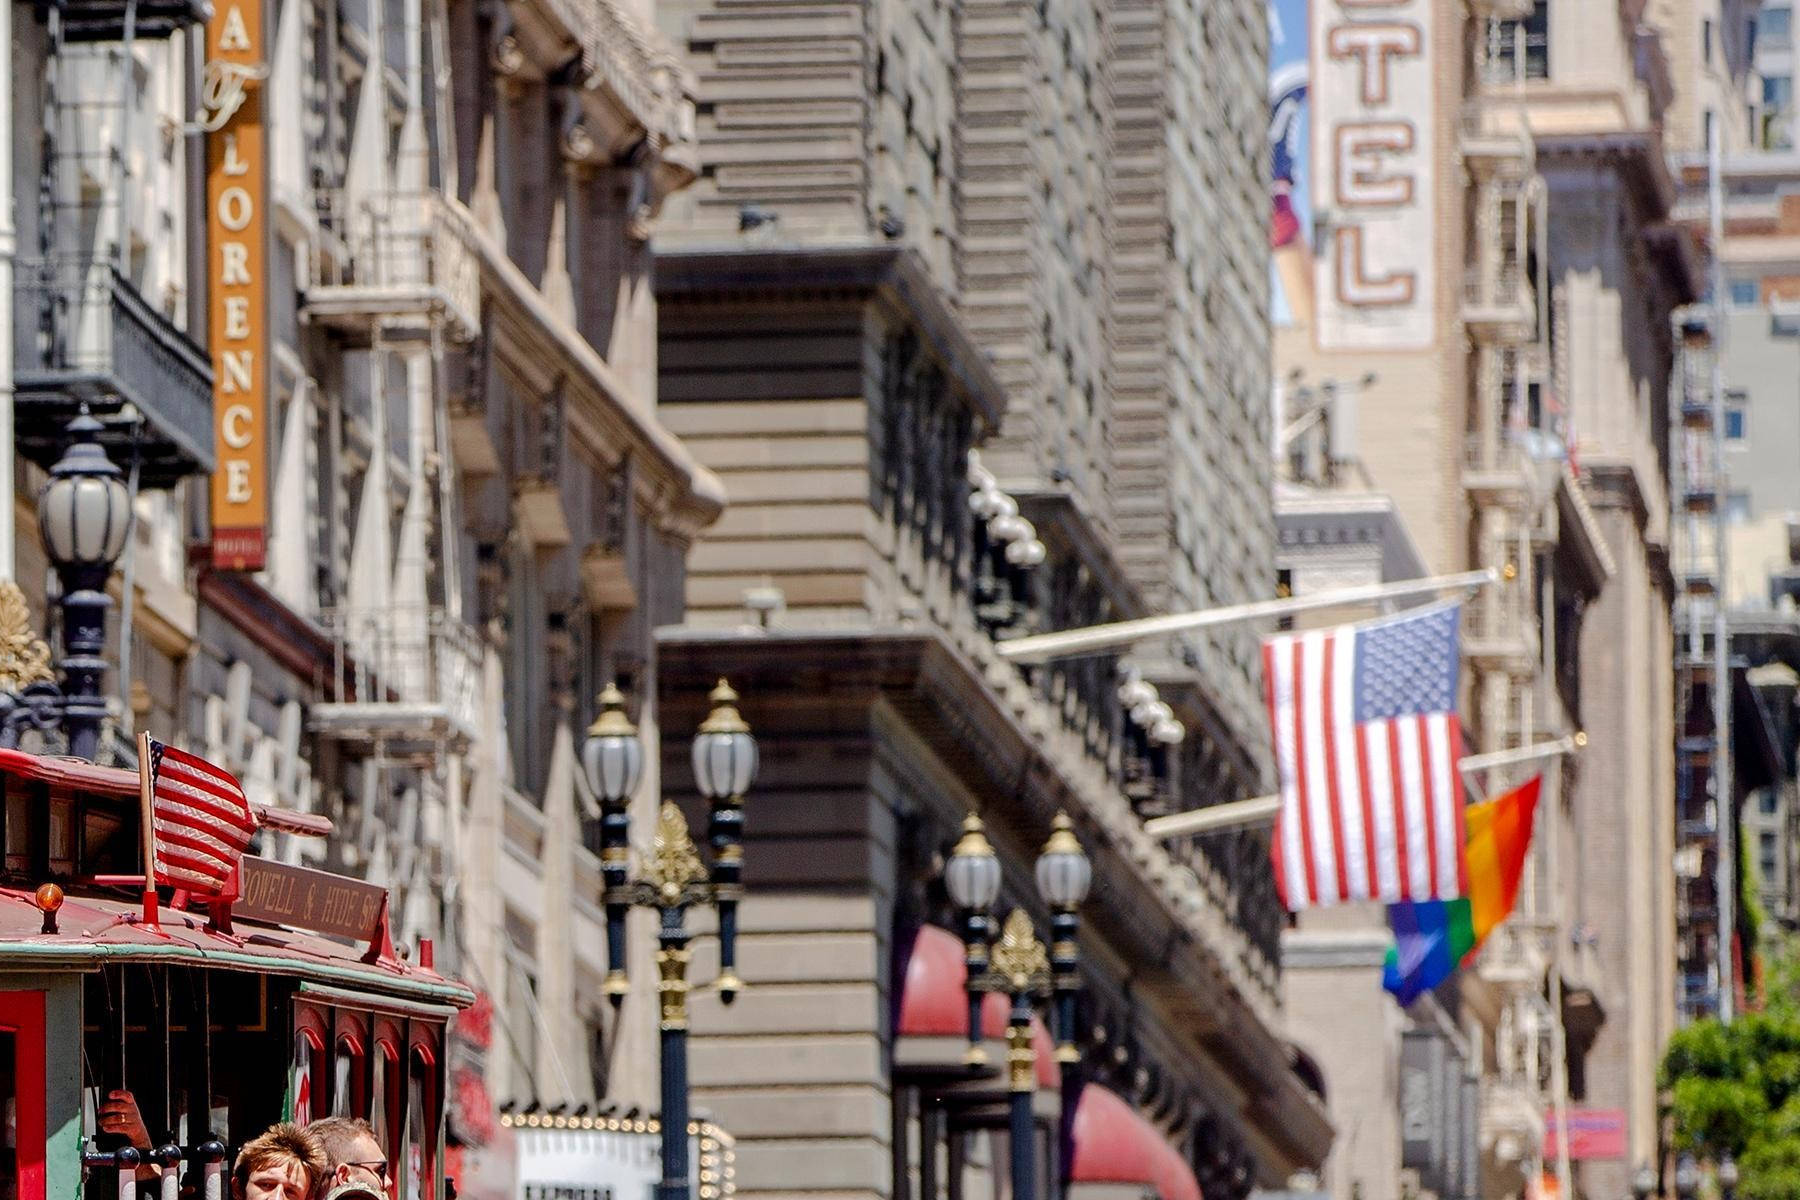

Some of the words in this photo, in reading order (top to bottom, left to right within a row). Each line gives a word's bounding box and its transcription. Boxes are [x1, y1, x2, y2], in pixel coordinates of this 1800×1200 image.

[1328, 0, 1422, 304] TEL
[303, 882, 316, 921] &
[321, 886, 359, 927] HYDE
